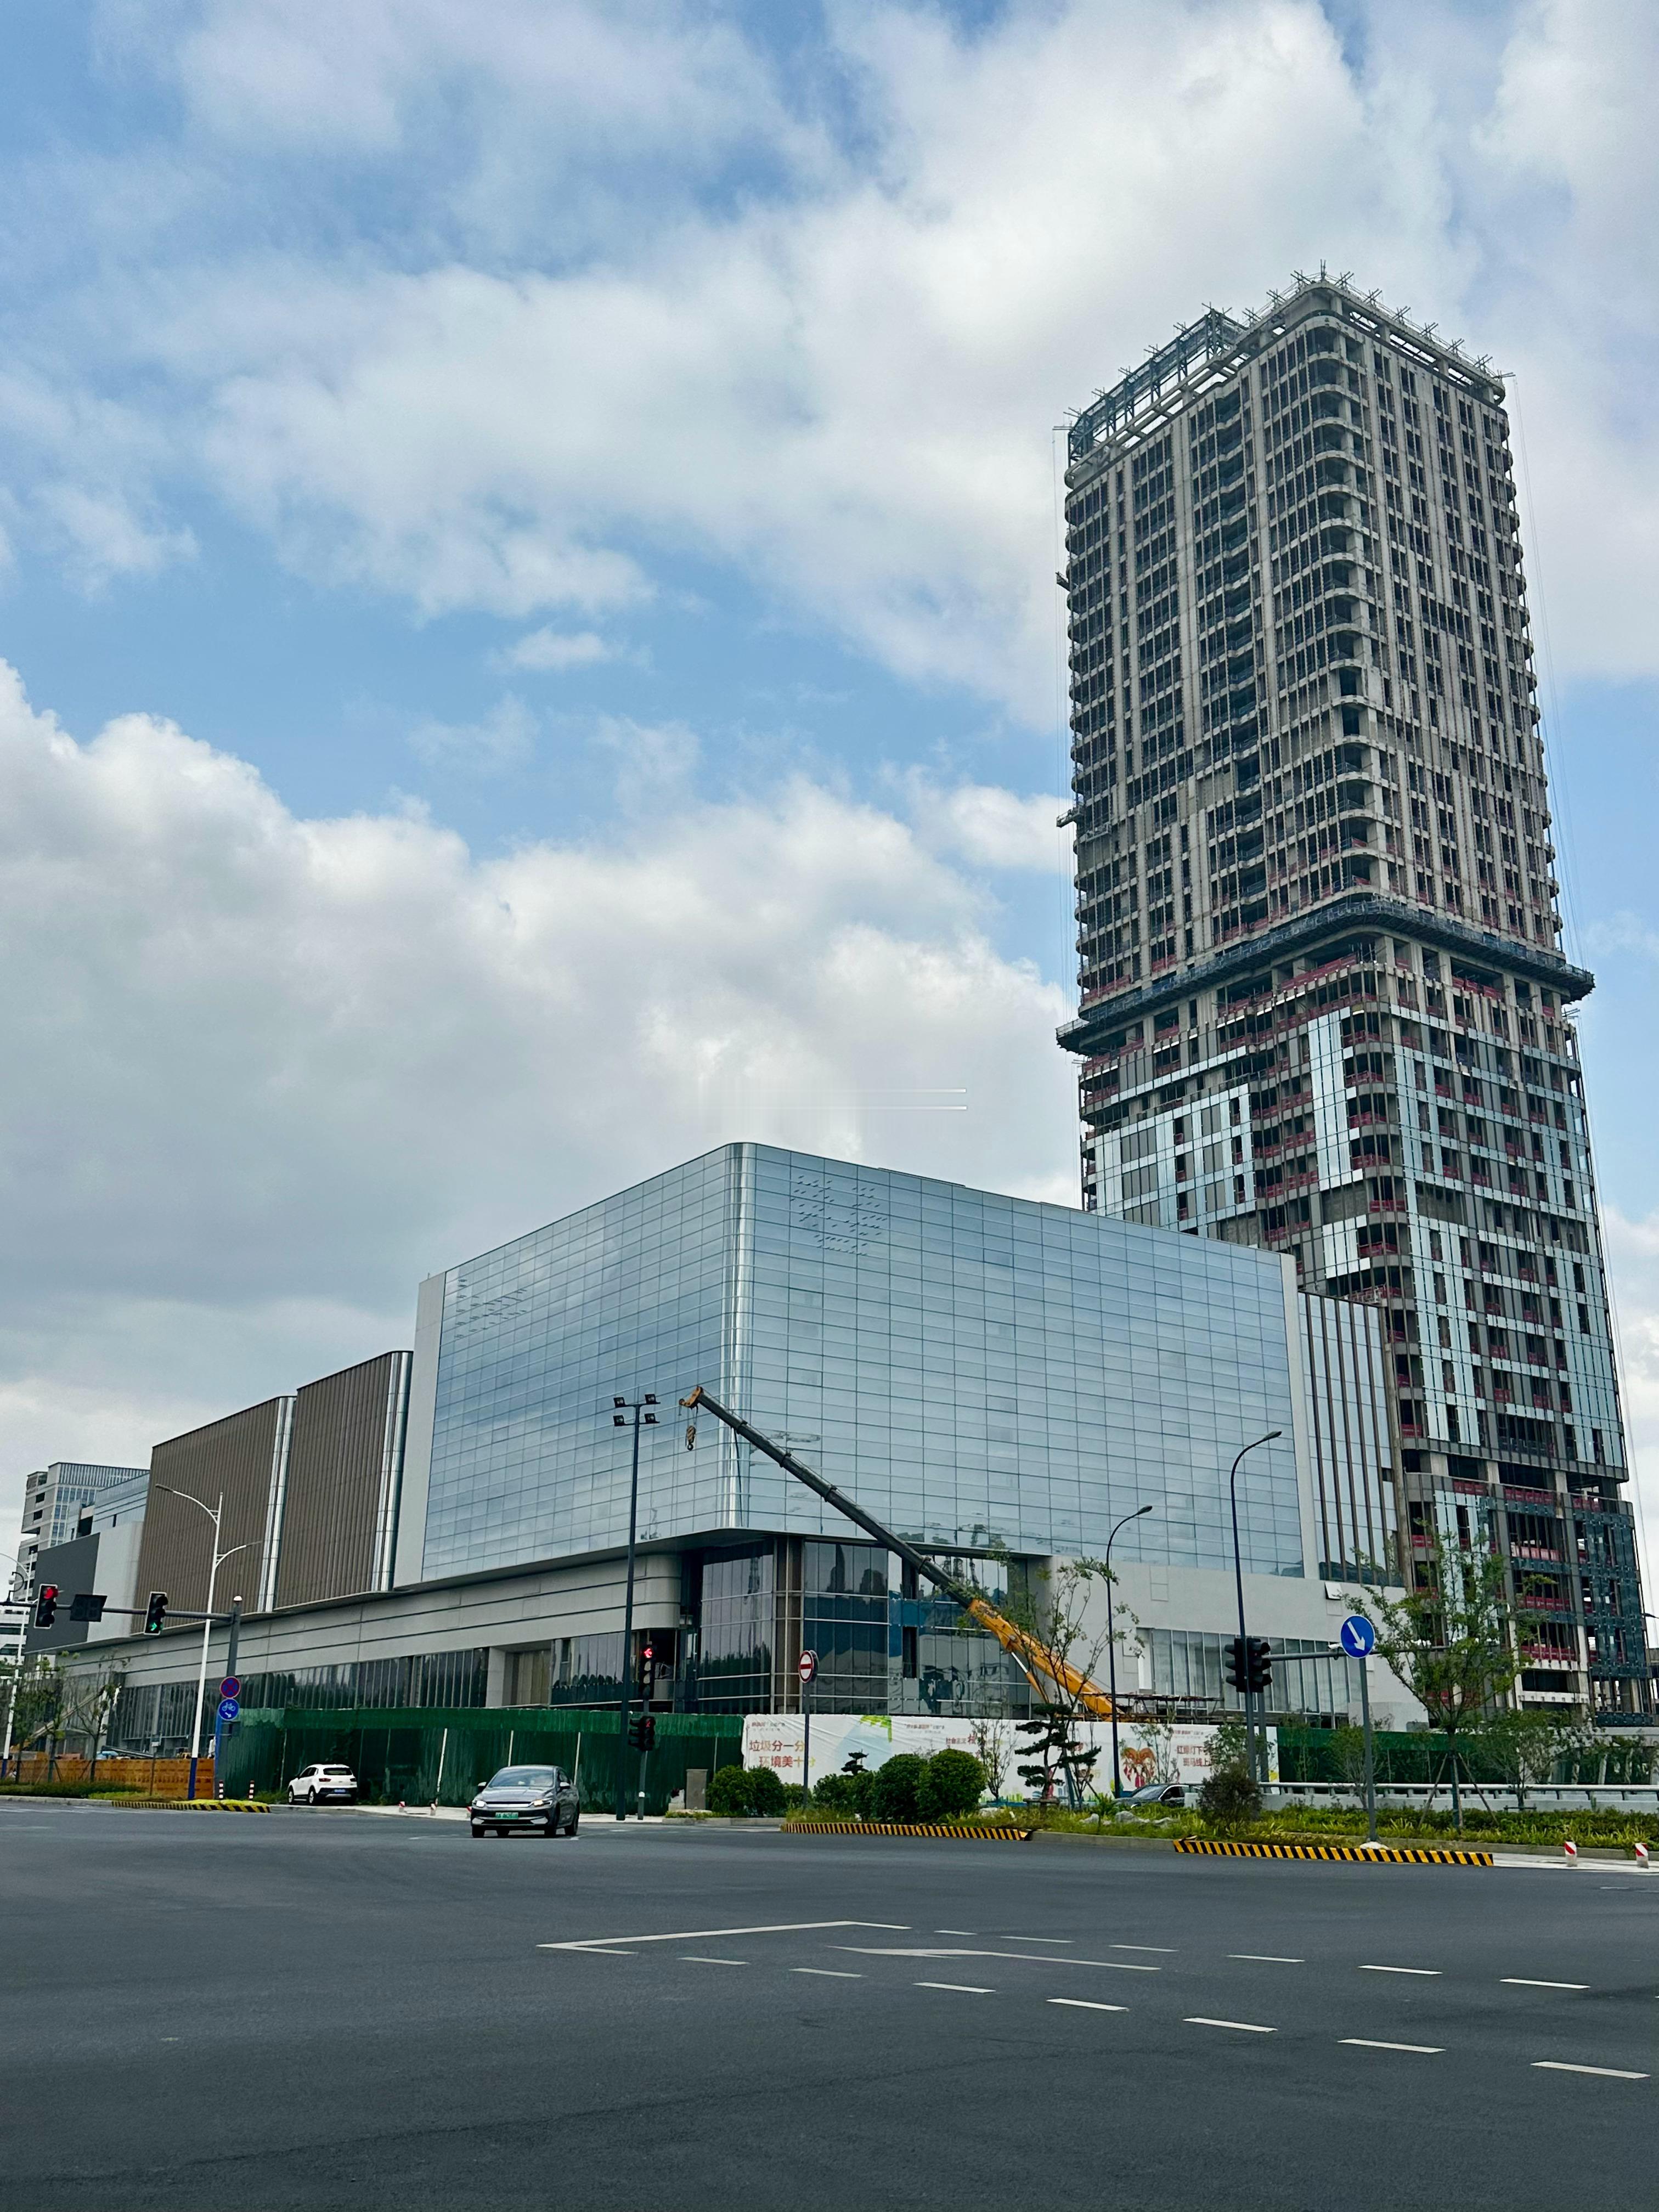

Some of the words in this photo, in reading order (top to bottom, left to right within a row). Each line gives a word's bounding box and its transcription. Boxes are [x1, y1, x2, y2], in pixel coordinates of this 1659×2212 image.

[749, 1740, 804, 1752] 垃圾分一分
